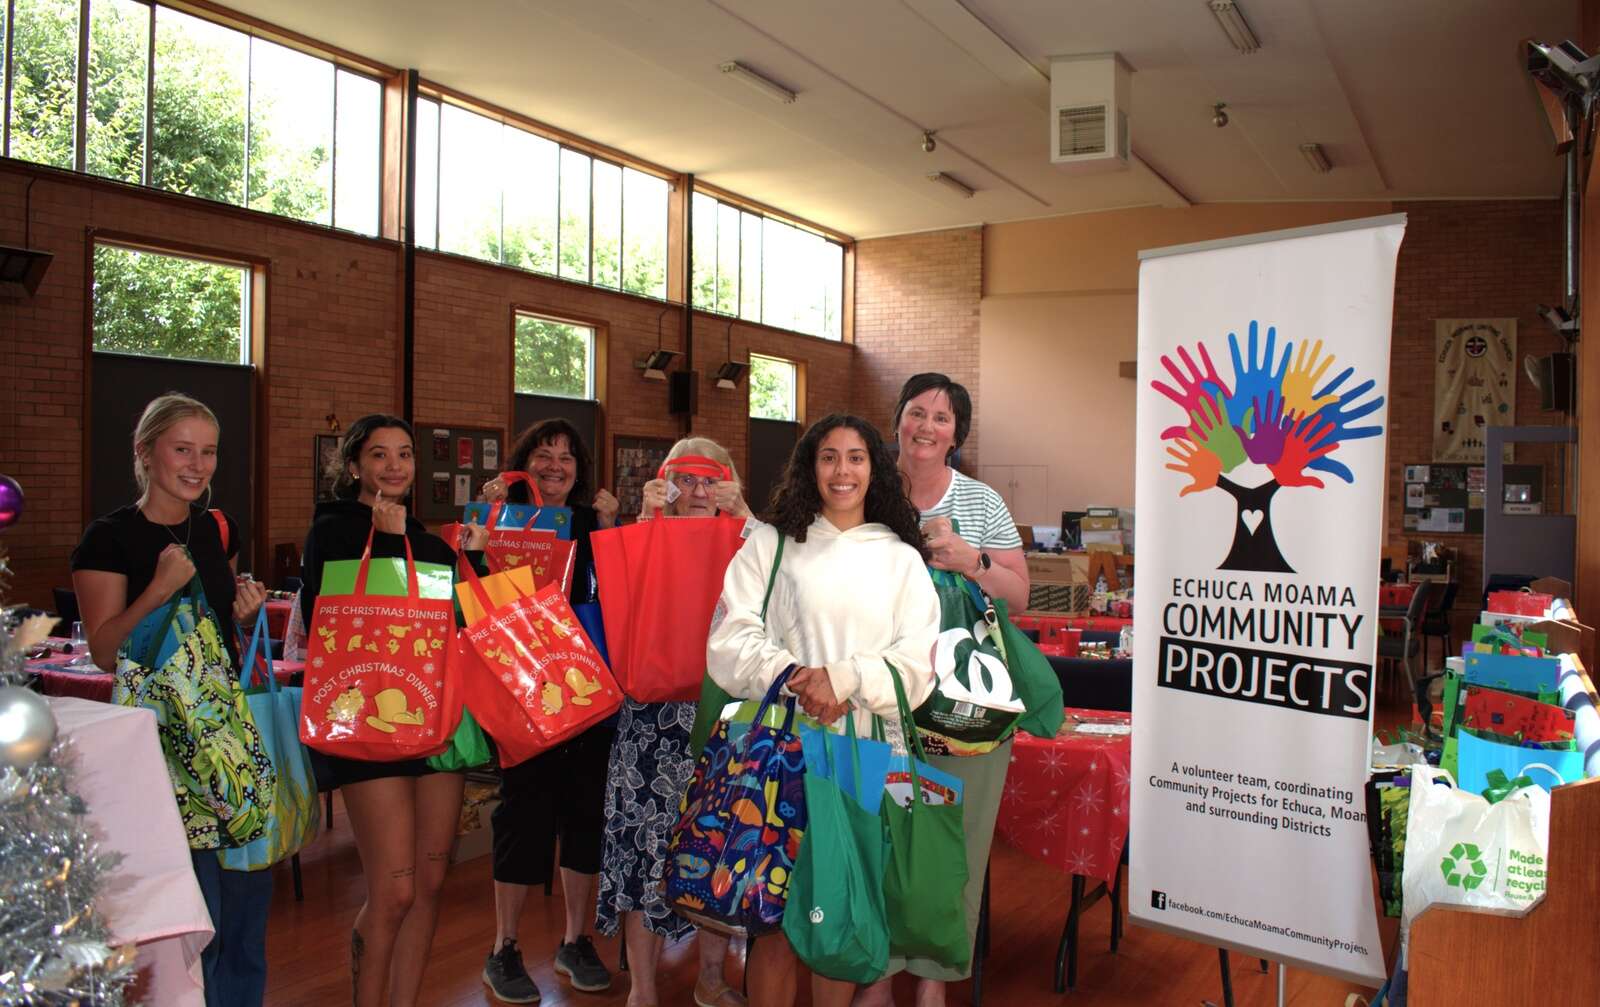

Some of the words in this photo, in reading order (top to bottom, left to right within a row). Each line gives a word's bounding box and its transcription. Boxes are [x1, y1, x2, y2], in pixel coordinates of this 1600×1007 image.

[1173, 578, 1254, 601] ECHUCA
[1264, 582, 1356, 608] MOAMA
[319, 605, 339, 615] PRE
[342, 605, 405, 617] CHRISTMAS
[407, 608, 448, 620] DINNER
[1163, 602, 1364, 650] COMMUNITY
[470, 629, 489, 643] PRE
[569, 652, 601, 675] DINNER
[1165, 643, 1369, 714] PROJECTS
[313, 676, 340, 705] POST
[339, 662, 406, 680] CHRISTMAS
[405, 673, 438, 710] DINNER
[1149, 775, 1209, 799] Community
[1212, 786, 1257, 806] Projects
[1261, 794, 1279, 808] for
[1282, 798, 1327, 819] Echuca,
[1171, 762, 1179, 773] A
[1182, 764, 1234, 783] volunteer
[1237, 773, 1271, 790] team,
[1274, 779, 1353, 804] coordinating
[1185, 801, 1206, 814] and
[1209, 806, 1278, 829] surrounding
[1282, 816, 1332, 837] Districts
[1507, 864, 1522, 875] at
[1509, 848, 1544, 865] Made
[1505, 878, 1546, 893] recycl
